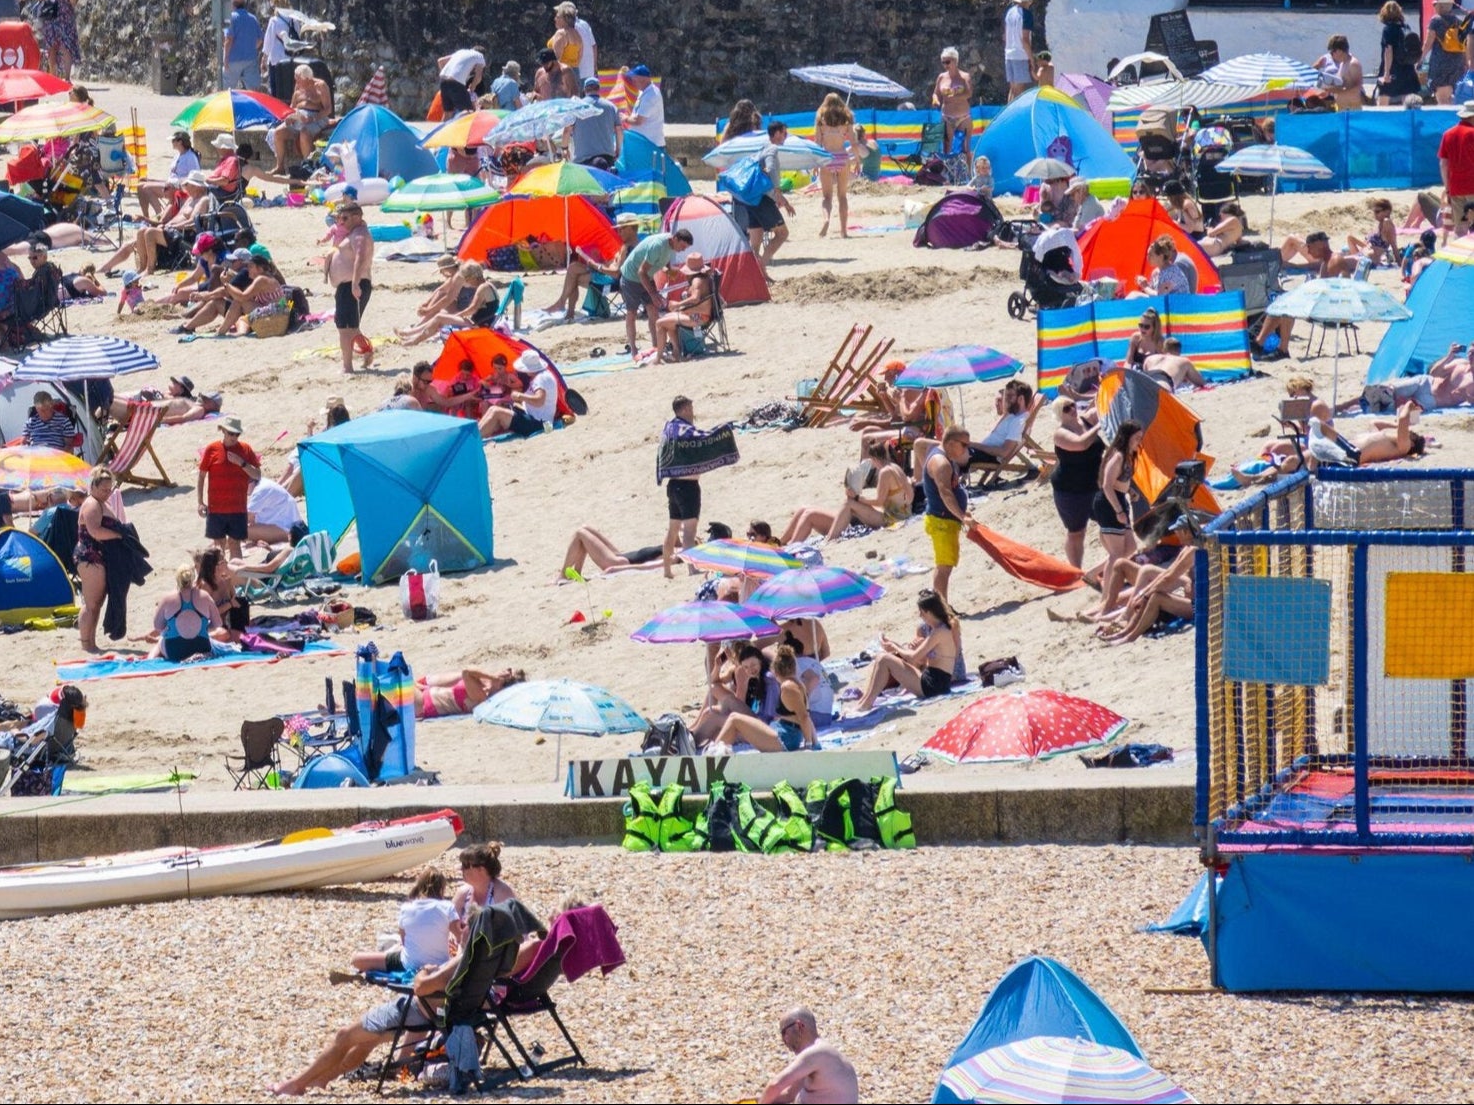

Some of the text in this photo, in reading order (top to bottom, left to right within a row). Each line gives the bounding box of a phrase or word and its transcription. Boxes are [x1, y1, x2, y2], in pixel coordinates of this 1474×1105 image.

[677, 431, 731, 449] WIMBLEDON
[580, 756, 730, 796] KAYAK
[385, 836, 424, 848] bluewave
